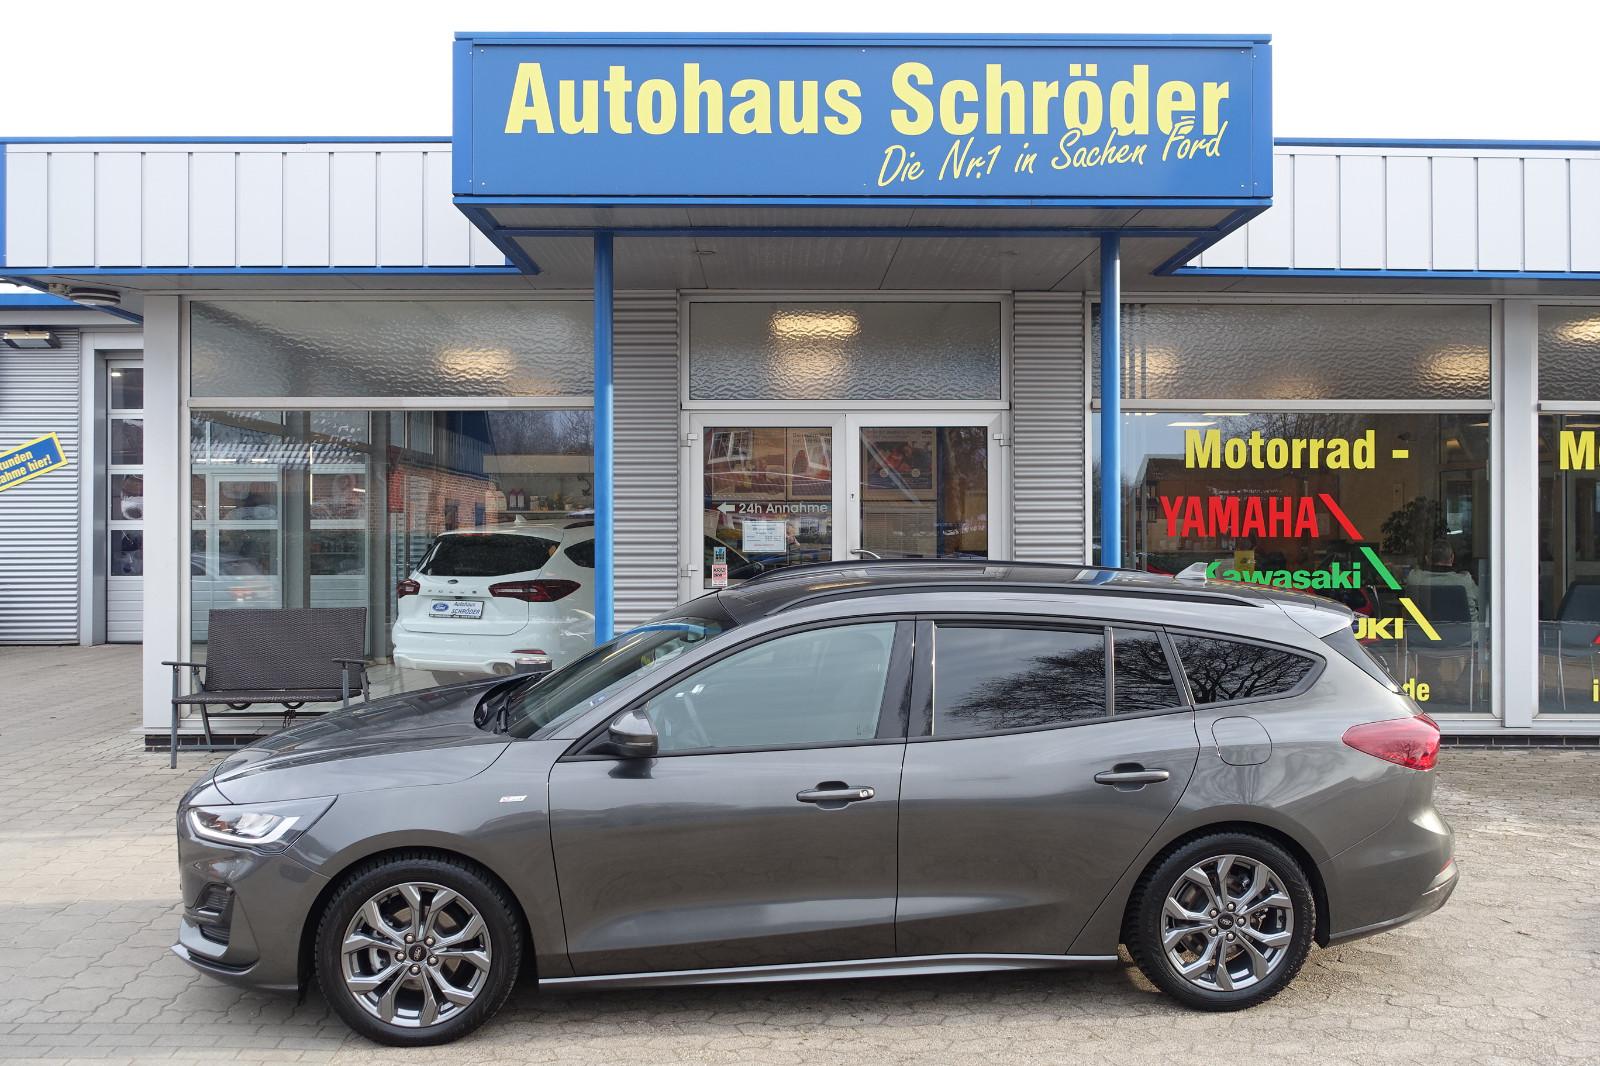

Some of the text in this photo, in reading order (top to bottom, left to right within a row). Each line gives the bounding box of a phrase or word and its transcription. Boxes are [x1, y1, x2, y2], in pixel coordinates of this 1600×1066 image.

[504, 61, 1229, 136] Autohaus Schröder
[878, 120, 1229, 186] Die Nr.1 in Sachen Ford
[0, 453, 52, 485] ahme hier!
[1184, 429, 1376, 470] Motorrad
[1559, 430, 1600, 470] M
[738, 502, 829, 515] 24h Annahme
[1159, 495, 1319, 538] YAMAHA
